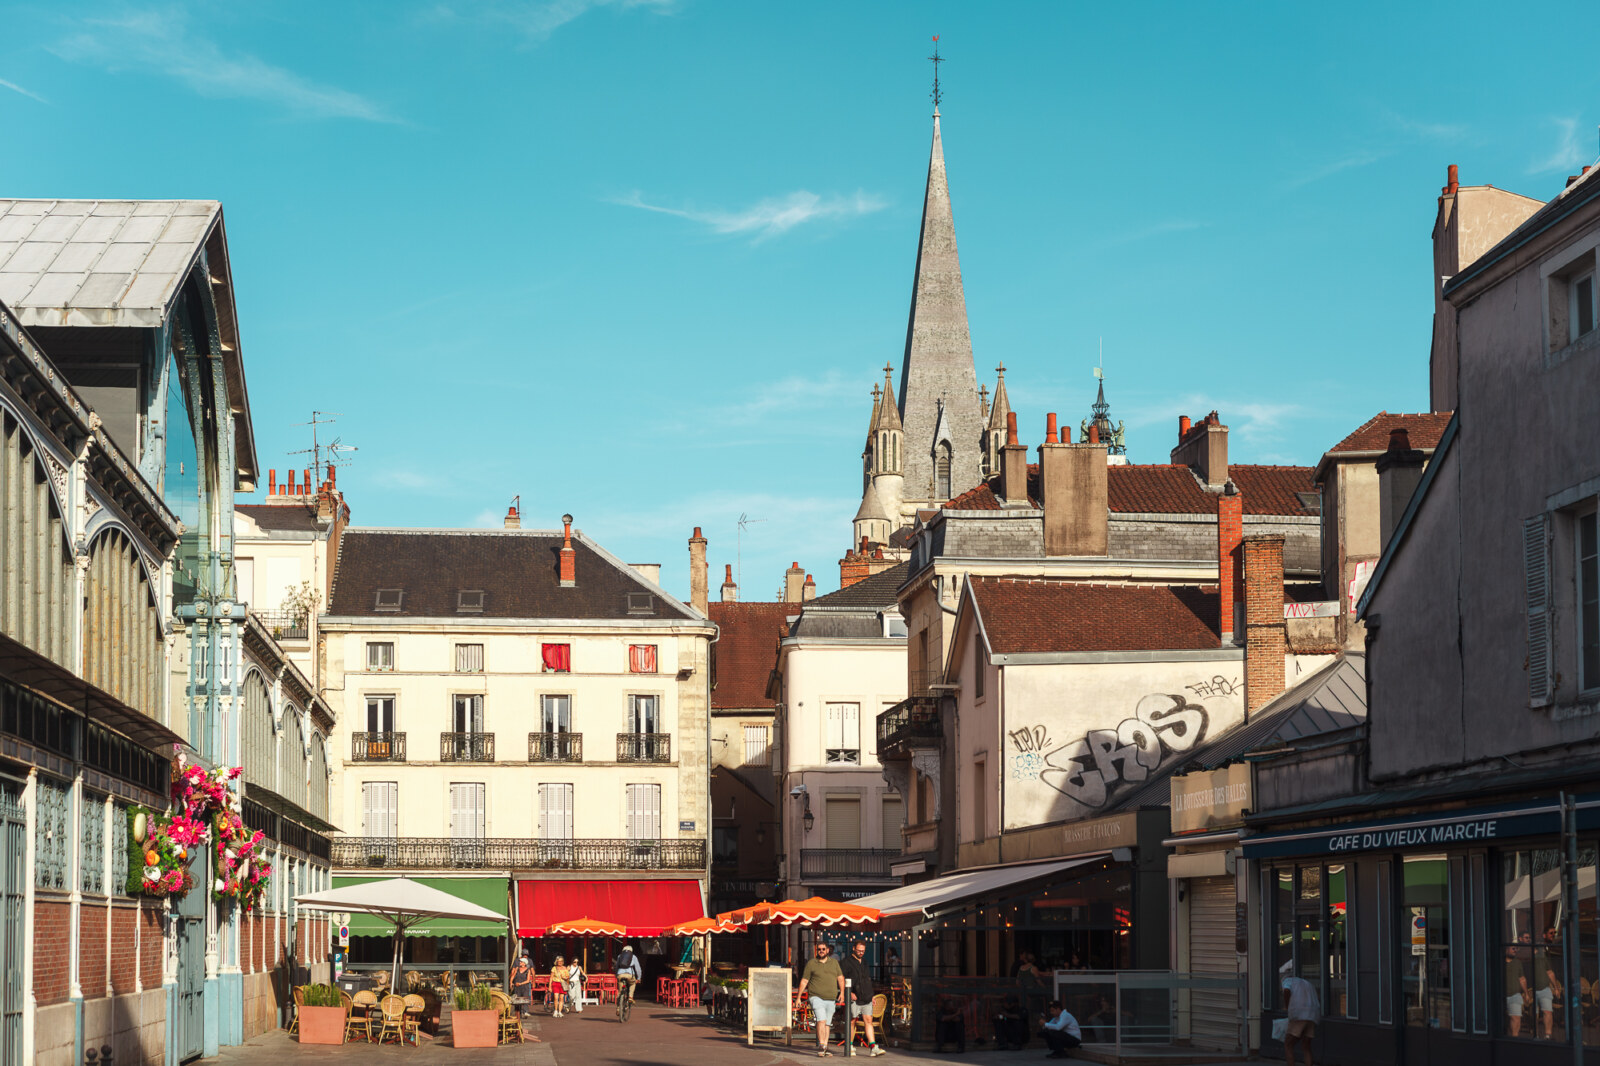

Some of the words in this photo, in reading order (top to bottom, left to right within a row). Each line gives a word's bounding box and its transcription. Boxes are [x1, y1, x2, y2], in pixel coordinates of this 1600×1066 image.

[1039, 693, 1209, 808] EROS
[1175, 795, 1183, 812] LA
[1225, 783, 1247, 804] HALLES
[1329, 835, 1360, 851] CAFE
[1363, 833, 1382, 848] DU
[1386, 828, 1427, 846] VIEUX
[1431, 821, 1497, 842] MARCHE
